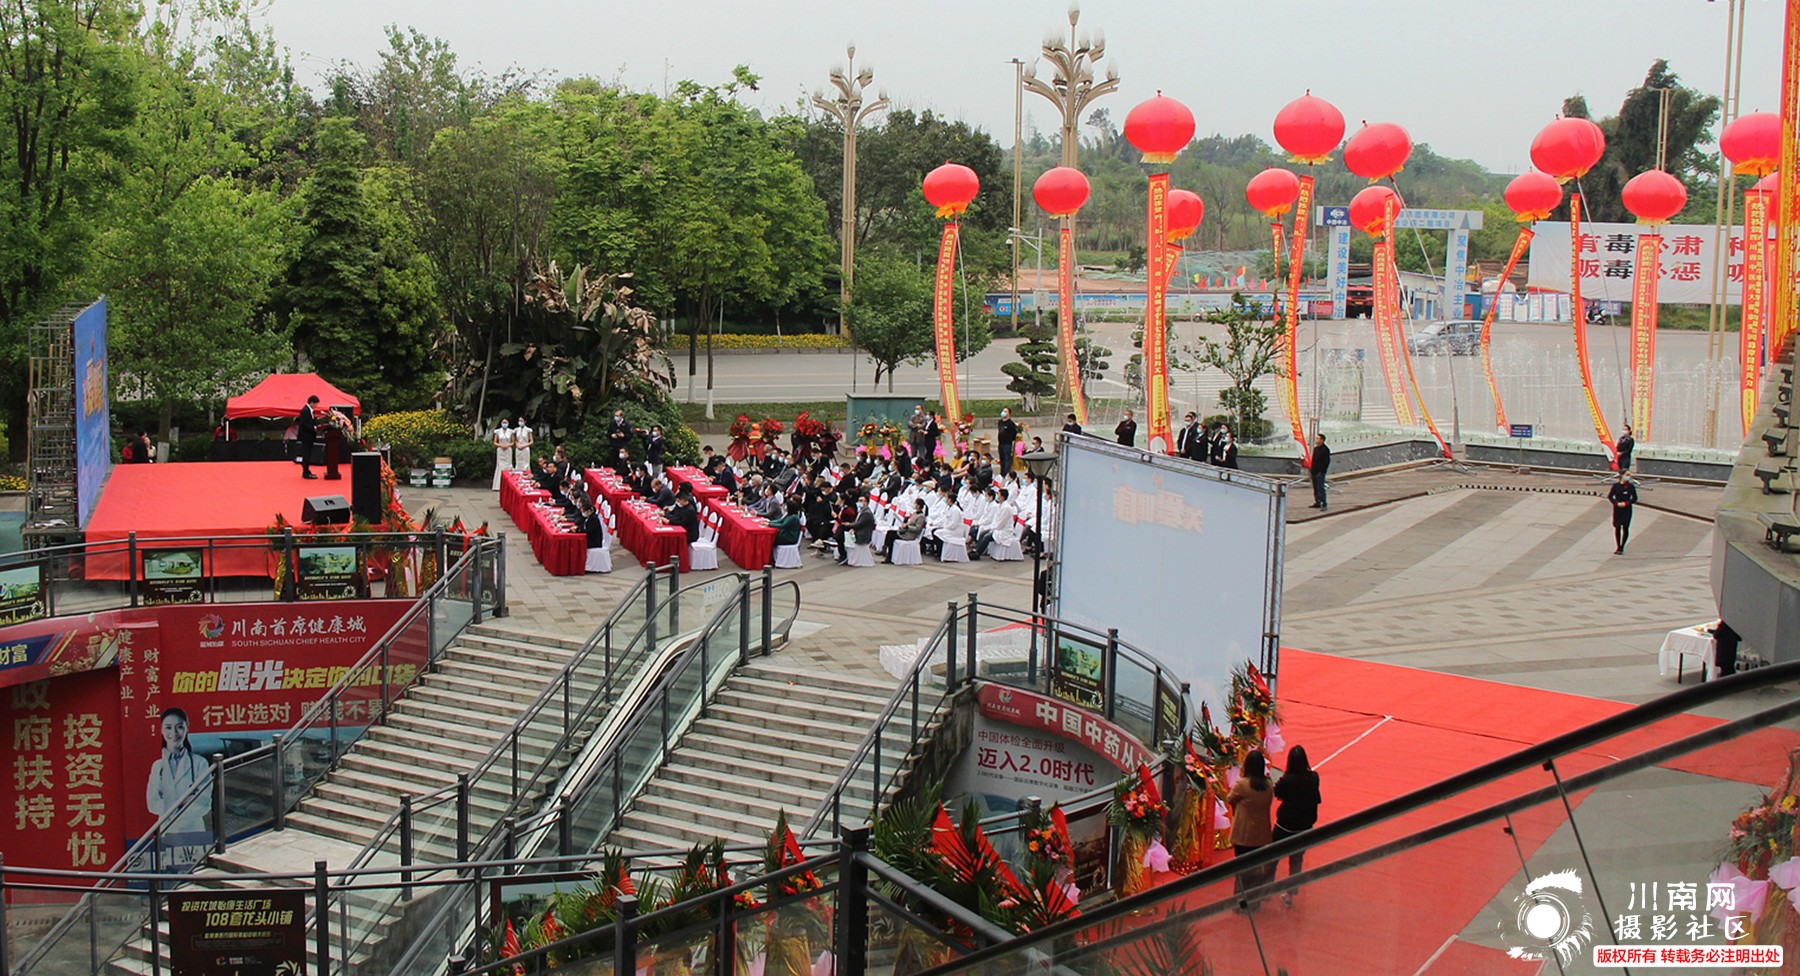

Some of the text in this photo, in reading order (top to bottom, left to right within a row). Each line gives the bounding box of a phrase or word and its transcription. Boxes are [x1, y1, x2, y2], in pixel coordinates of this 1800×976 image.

[1334, 232, 1348, 319] 建设美好中冶
[1452, 235, 1467, 320] 聚焦中冶主业
[230, 615, 367, 638] 川南首席健康城
[231, 639, 259, 647] SOUTH
[259, 638, 295, 647] SICHUAN
[295, 637, 318, 645] CHIEF
[319, 636, 348, 644] HEALTH
[202, 701, 292, 727] 行业选对
[11, 681, 55, 831] 政府扶持
[977, 730, 1066, 754] 中国体检全面升级
[977, 747, 1095, 786] 迈入2.0时代
[63, 713, 107, 867] 投资无忧
[205, 910, 294, 927] 108套龙头小铺
